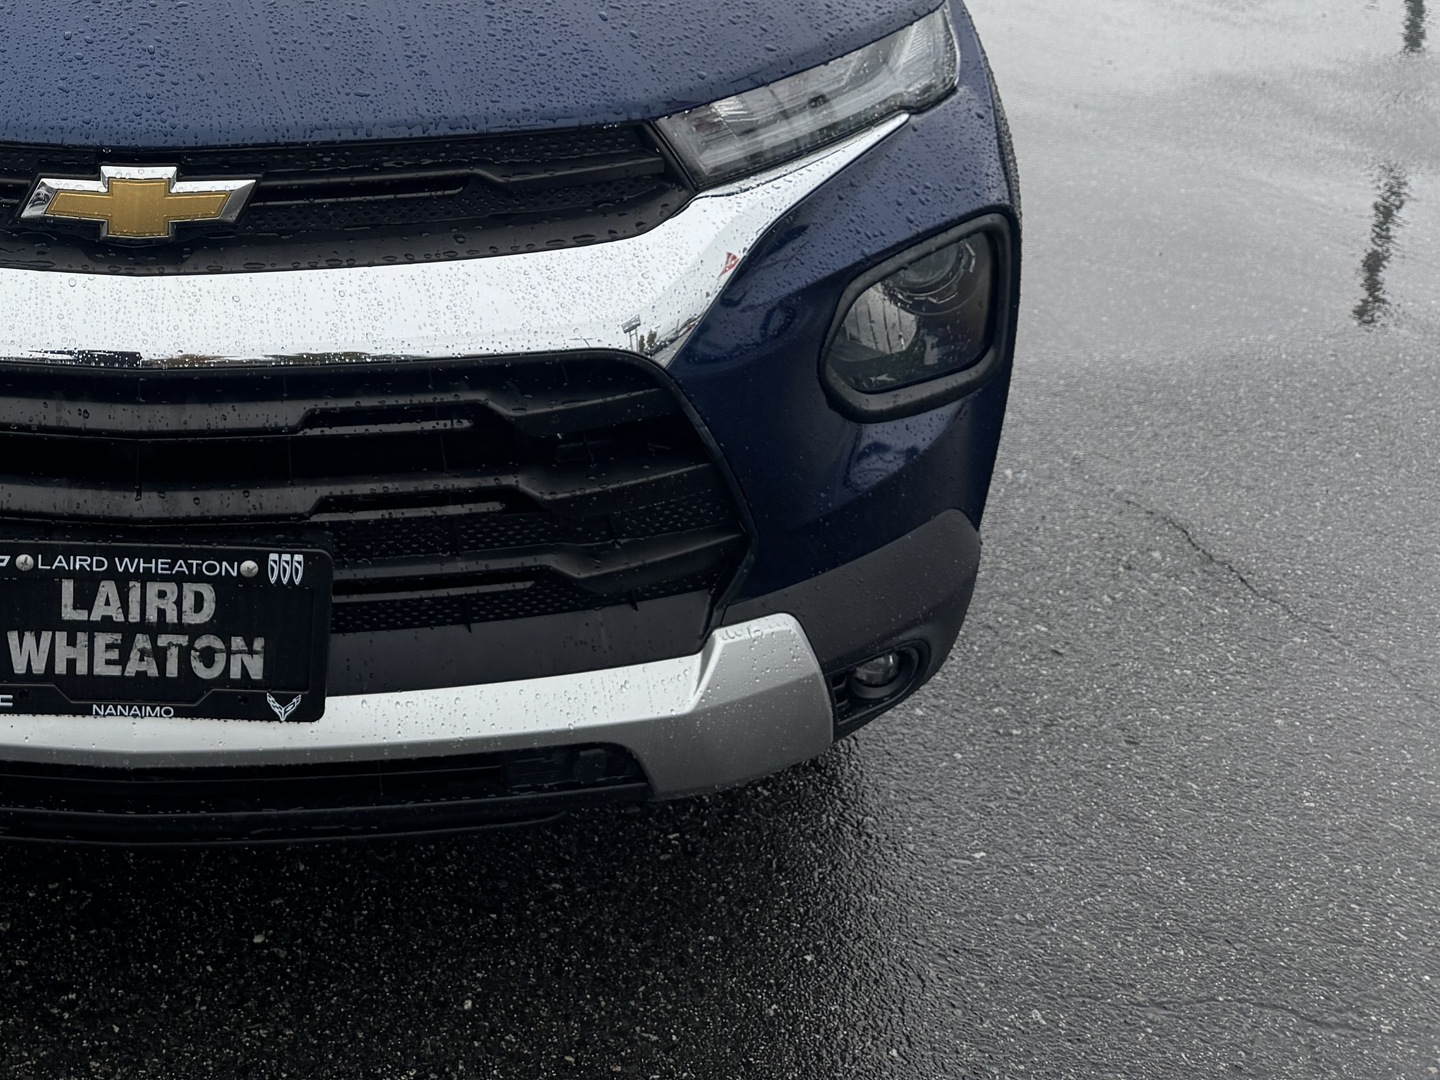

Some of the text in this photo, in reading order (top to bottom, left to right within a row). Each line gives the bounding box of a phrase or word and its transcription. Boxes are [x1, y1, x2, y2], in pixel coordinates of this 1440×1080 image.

[37, 554, 239, 577] LAIRD WHEATON
[60, 578, 217, 625] LAIRD
[6, 630, 265, 680] WHEATON
[92, 703, 174, 719] NANAIMO
